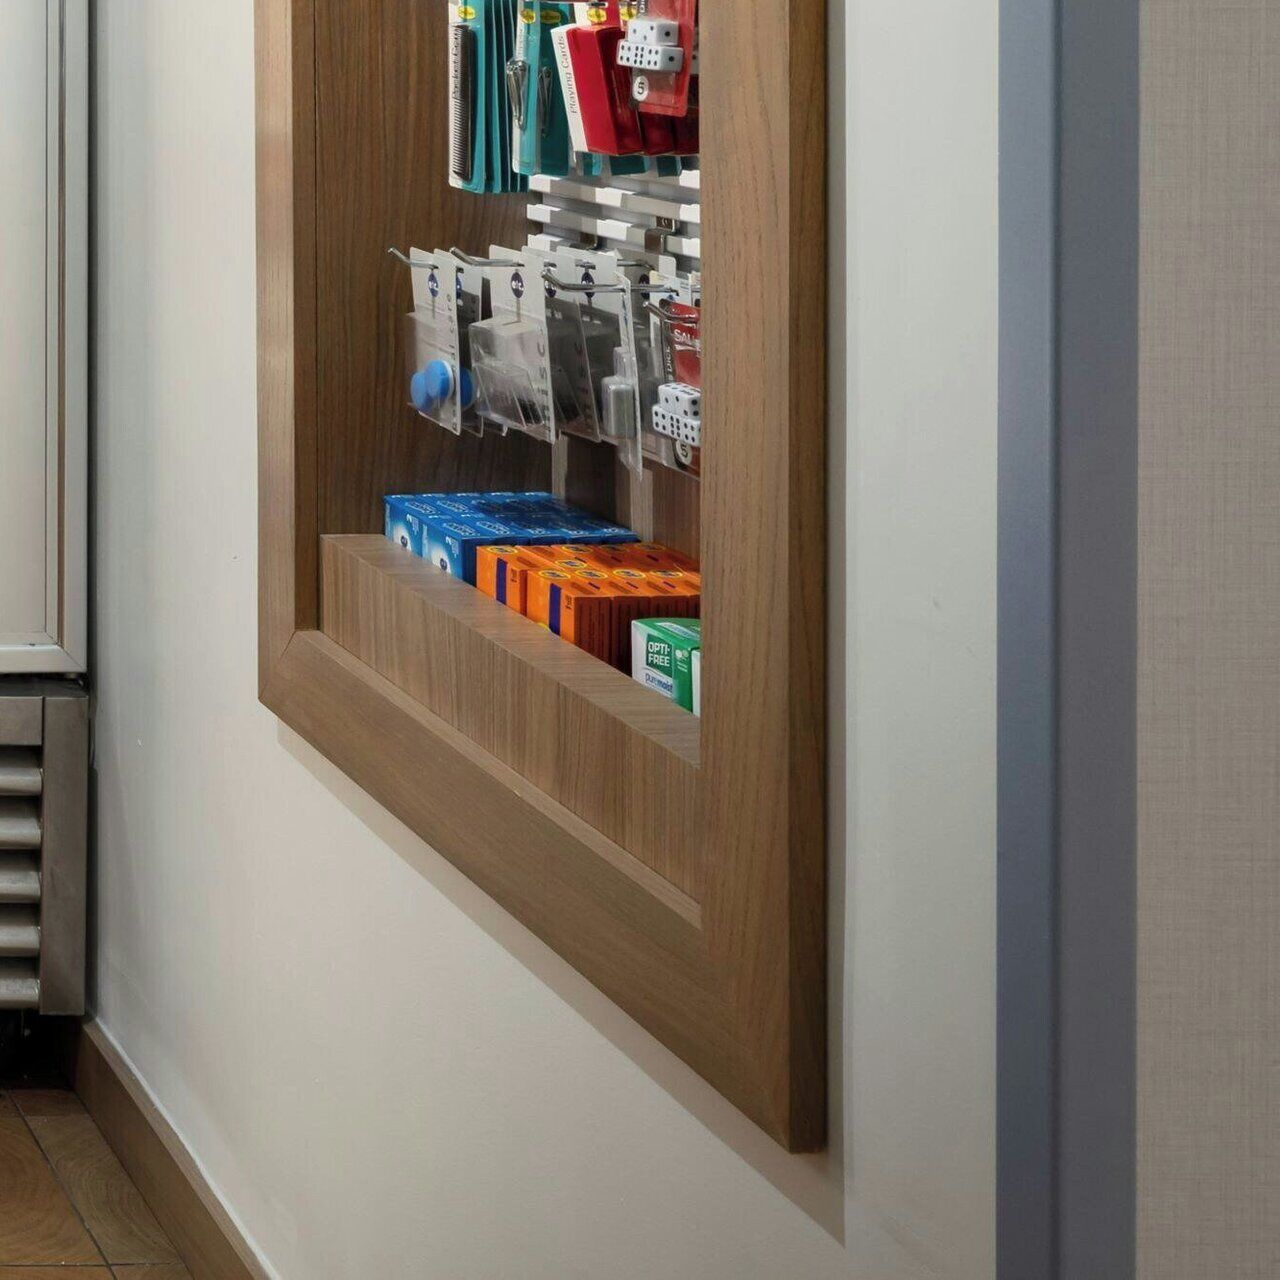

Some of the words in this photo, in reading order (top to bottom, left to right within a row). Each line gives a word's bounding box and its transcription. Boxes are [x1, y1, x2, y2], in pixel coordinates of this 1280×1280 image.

[557, 34, 570, 70] Cards
[566, 70, 580, 115] Playing
[647, 641, 671, 655] OPTI-
[648, 654, 671, 667] FREE
